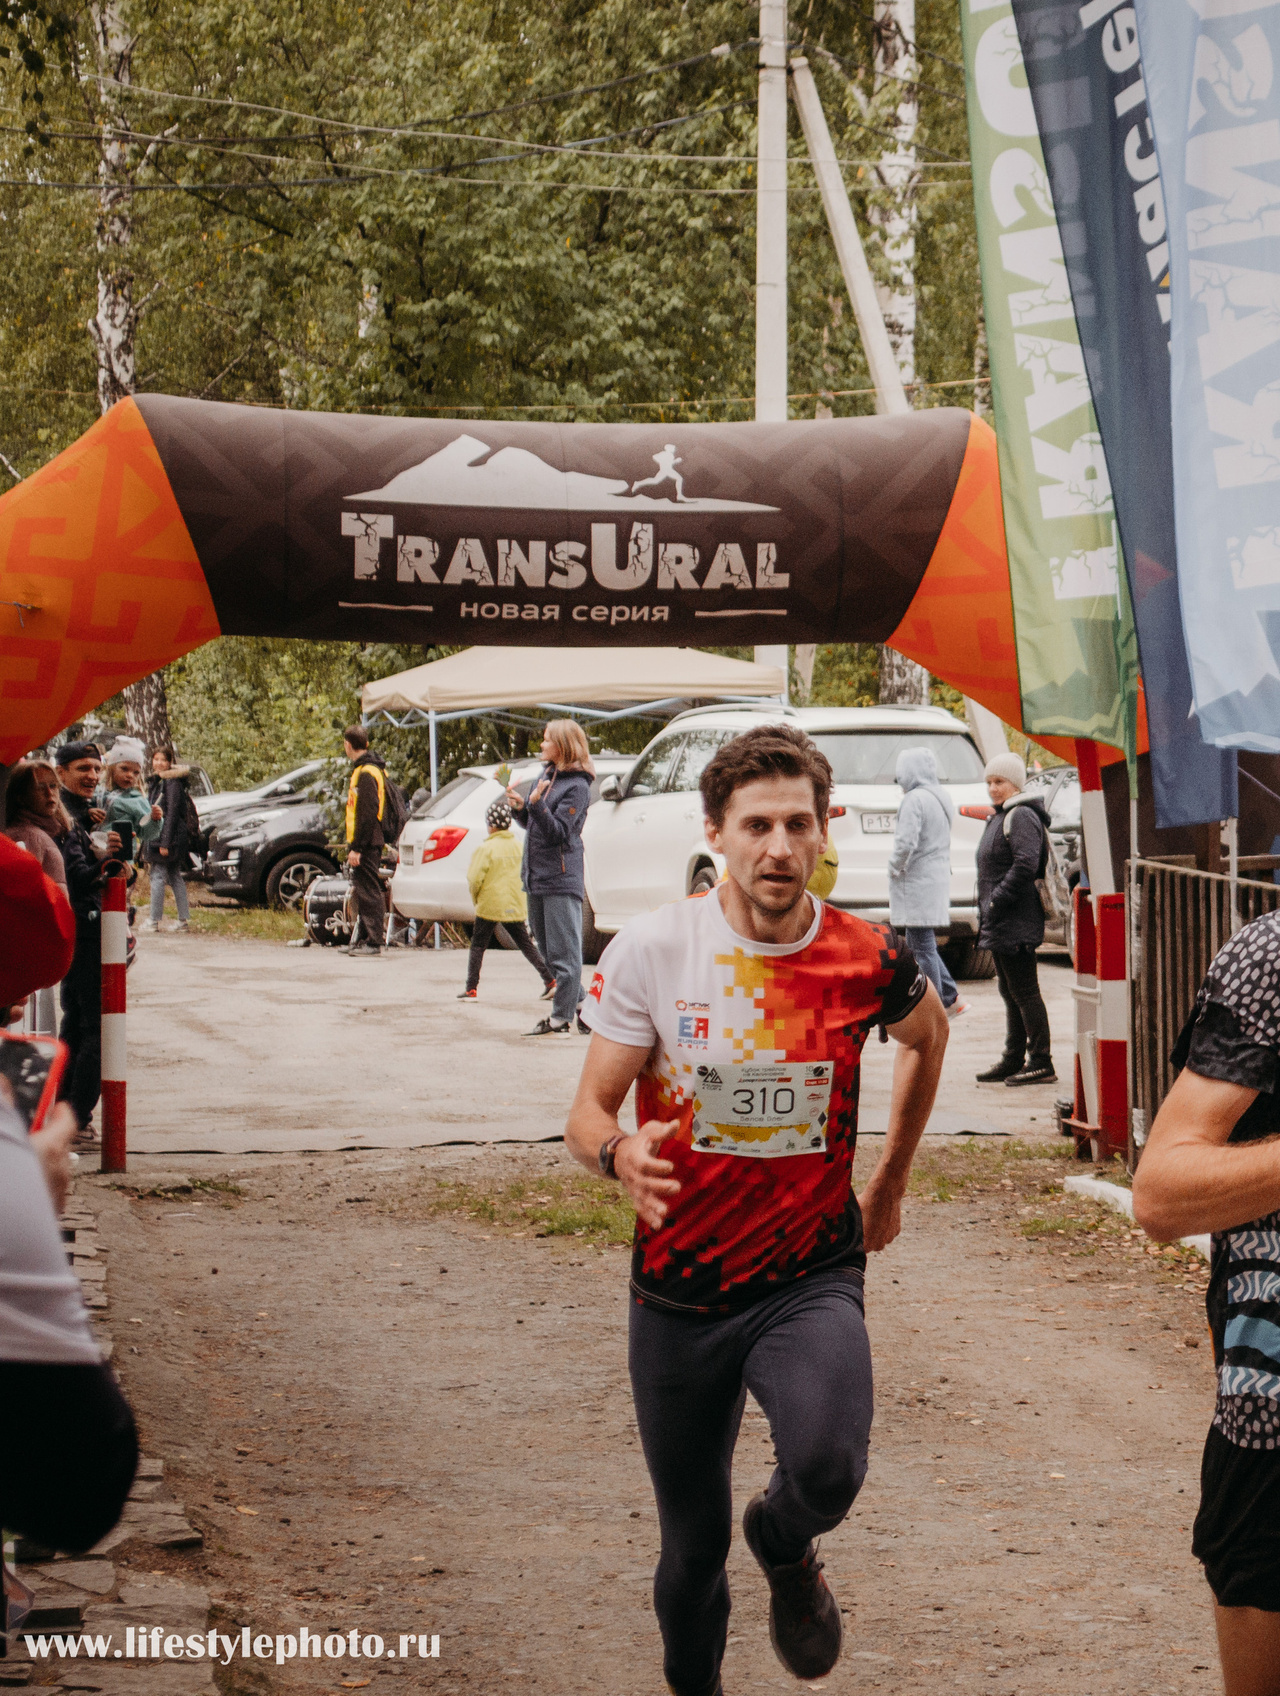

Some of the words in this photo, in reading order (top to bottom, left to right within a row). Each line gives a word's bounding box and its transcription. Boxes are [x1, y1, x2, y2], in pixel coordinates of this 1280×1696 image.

[459, 602, 560, 620] новая
[571, 603, 669, 626] серия
[732, 1087, 794, 1115] 310
